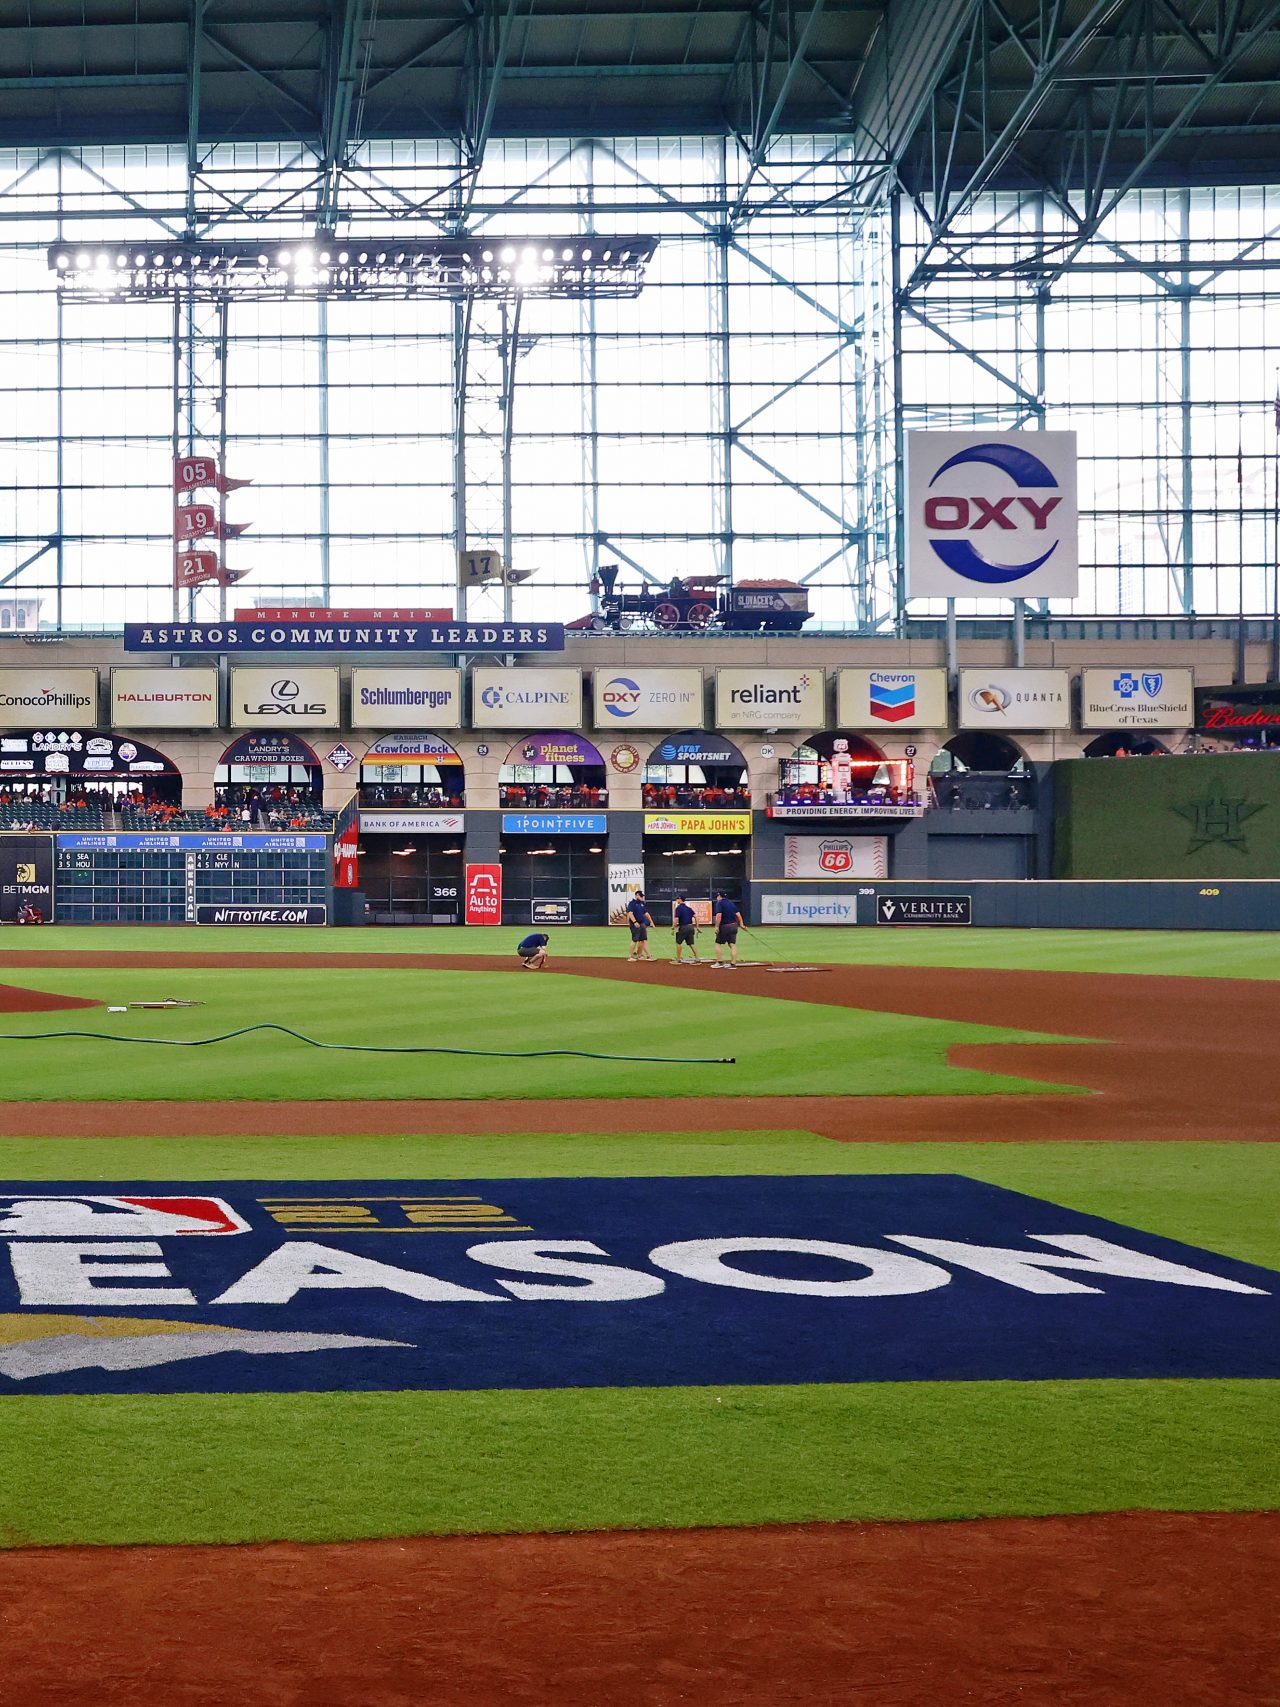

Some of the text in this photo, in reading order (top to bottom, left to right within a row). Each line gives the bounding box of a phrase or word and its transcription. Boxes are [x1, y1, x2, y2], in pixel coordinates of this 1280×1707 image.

[183, 463, 207, 482] 05
[925, 496, 1064, 531] OXY
[185, 512, 207, 531] 19
[183, 558, 205, 576] 21
[468, 556, 491, 576] 17
[257, 611, 433, 619] MINUTE MAID
[251, 629, 418, 644] COMMUNITY
[431, 629, 548, 643] LEADERS
[869, 672, 916, 683] Chevron
[117, 694, 212, 702] HALLIBURTON
[360, 687, 452, 708] Schlumberger
[505, 691, 570, 704] CALPINE
[602, 692, 676, 703] OXY ZERO
[730, 684, 802, 704] reliant
[1015, 692, 1063, 703] QUANTA
[243, 703, 327, 715] LEXUS
[1089, 703, 1188, 713] BlueCross BlueShield
[742, 711, 763, 719] NRG
[763, 712, 801, 721] company
[1118, 716, 1159, 724] of Texas
[32, 742, 83, 752] LANDRY'S
[374, 744, 449, 754] Crawford Bock
[540, 743, 578, 754] planet
[677, 745, 701, 753] AT&T
[545, 752, 585, 763] fitness
[677, 752, 732, 761] SPORTSNET
[829, 807, 859, 815] ENERGY.
[860, 807, 898, 815] IMPROVING
[516, 820, 594, 829] 1POINTFIVE
[680, 820, 745, 831] PAPA JOHN'S
[824, 854, 847, 867] 66
[2, 885, 50, 894] BETMGM
[611, 883, 641, 893] WM
[1199, 888, 1220, 896] 409
[470, 895, 498, 906] Auto
[470, 905, 497, 914] Anything
[785, 902, 851, 917] Insperity
[899, 902, 965, 913] VERITEX
[214, 909, 308, 923] NITTOTIRE.COM
